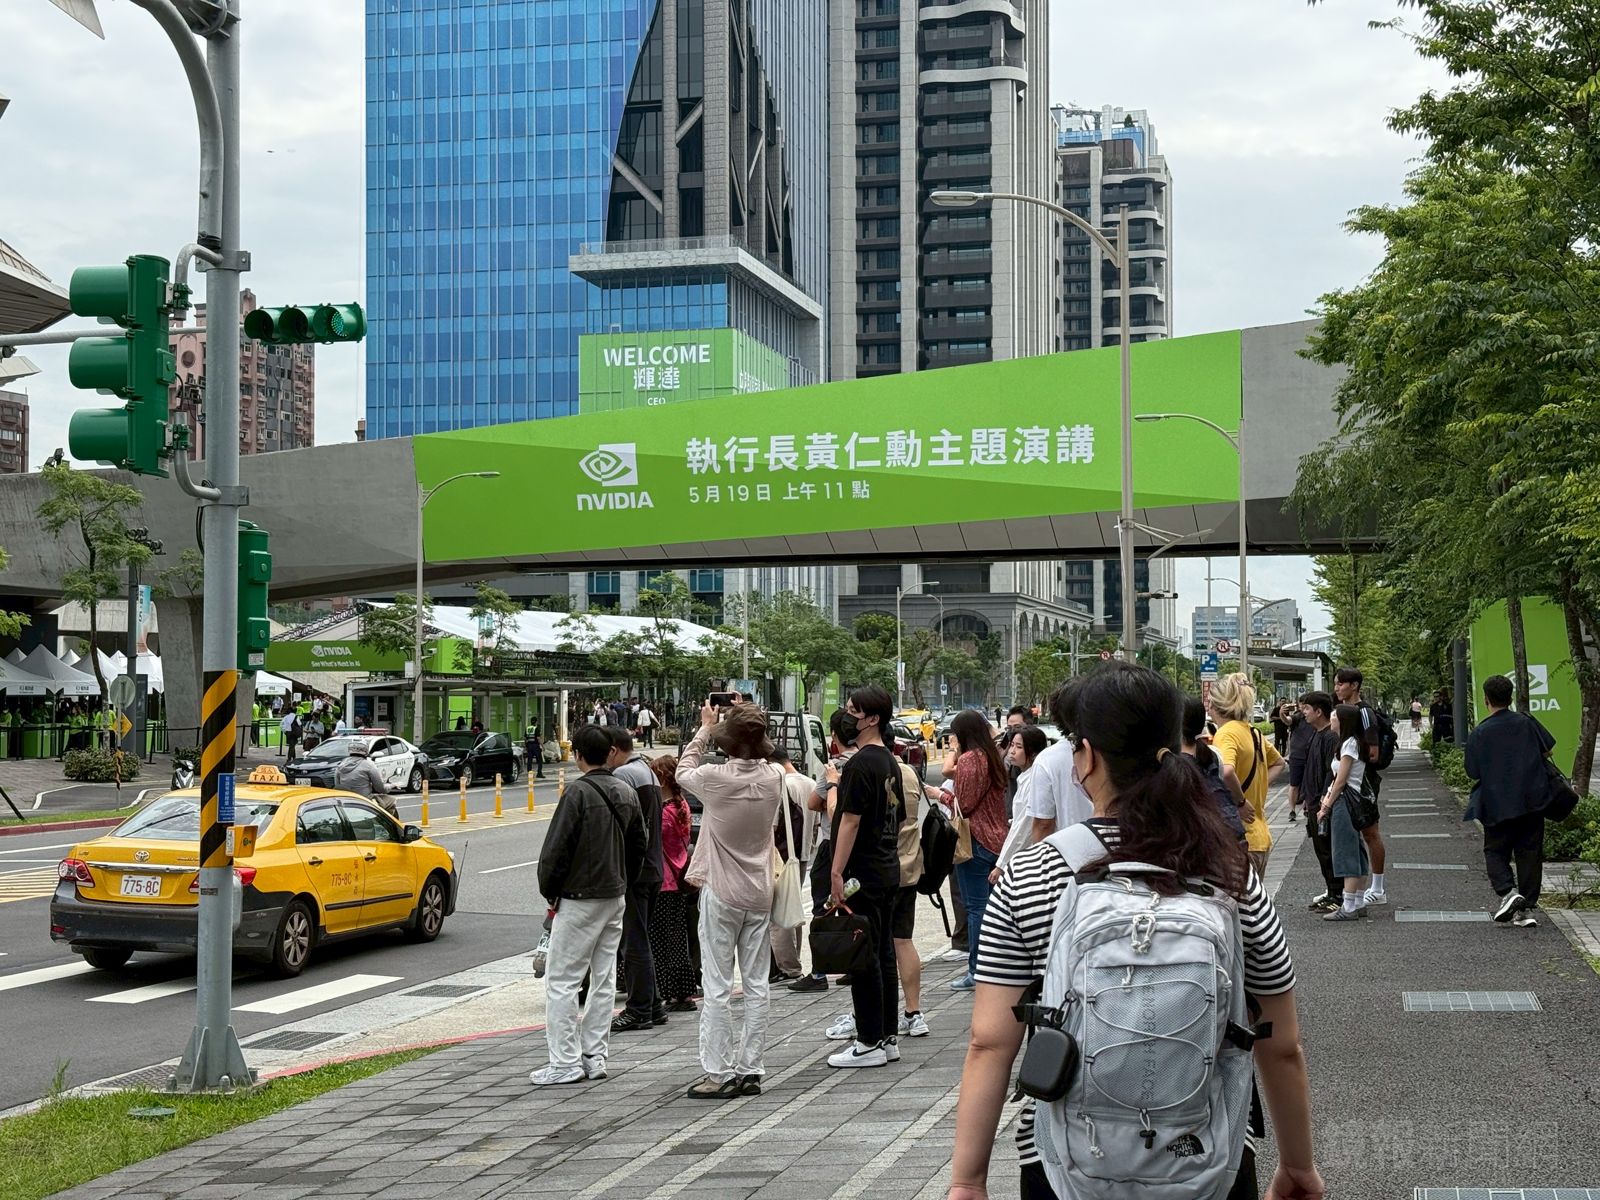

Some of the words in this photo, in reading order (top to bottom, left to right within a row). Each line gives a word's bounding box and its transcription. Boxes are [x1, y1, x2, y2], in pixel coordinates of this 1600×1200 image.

[603, 343, 711, 367] WELCOME
[633, 367, 680, 391] 輝達
[647, 397, 666, 406] CEO
[686, 424, 1095, 476] 執行長黃仁勳主題演講
[576, 491, 654, 511] NVIDIA
[323, 646, 352, 656] NVIDIA
[1201, 655, 1210, 665] P
[252, 774, 280, 782] TAXI
[331, 872, 352, 886] 775-8C
[123, 878, 160, 895] 775-8C
[1177, 1135, 1190, 1143] THE
[1166, 1141, 1194, 1152] NORTH
[1174, 1149, 1194, 1158] FACE
